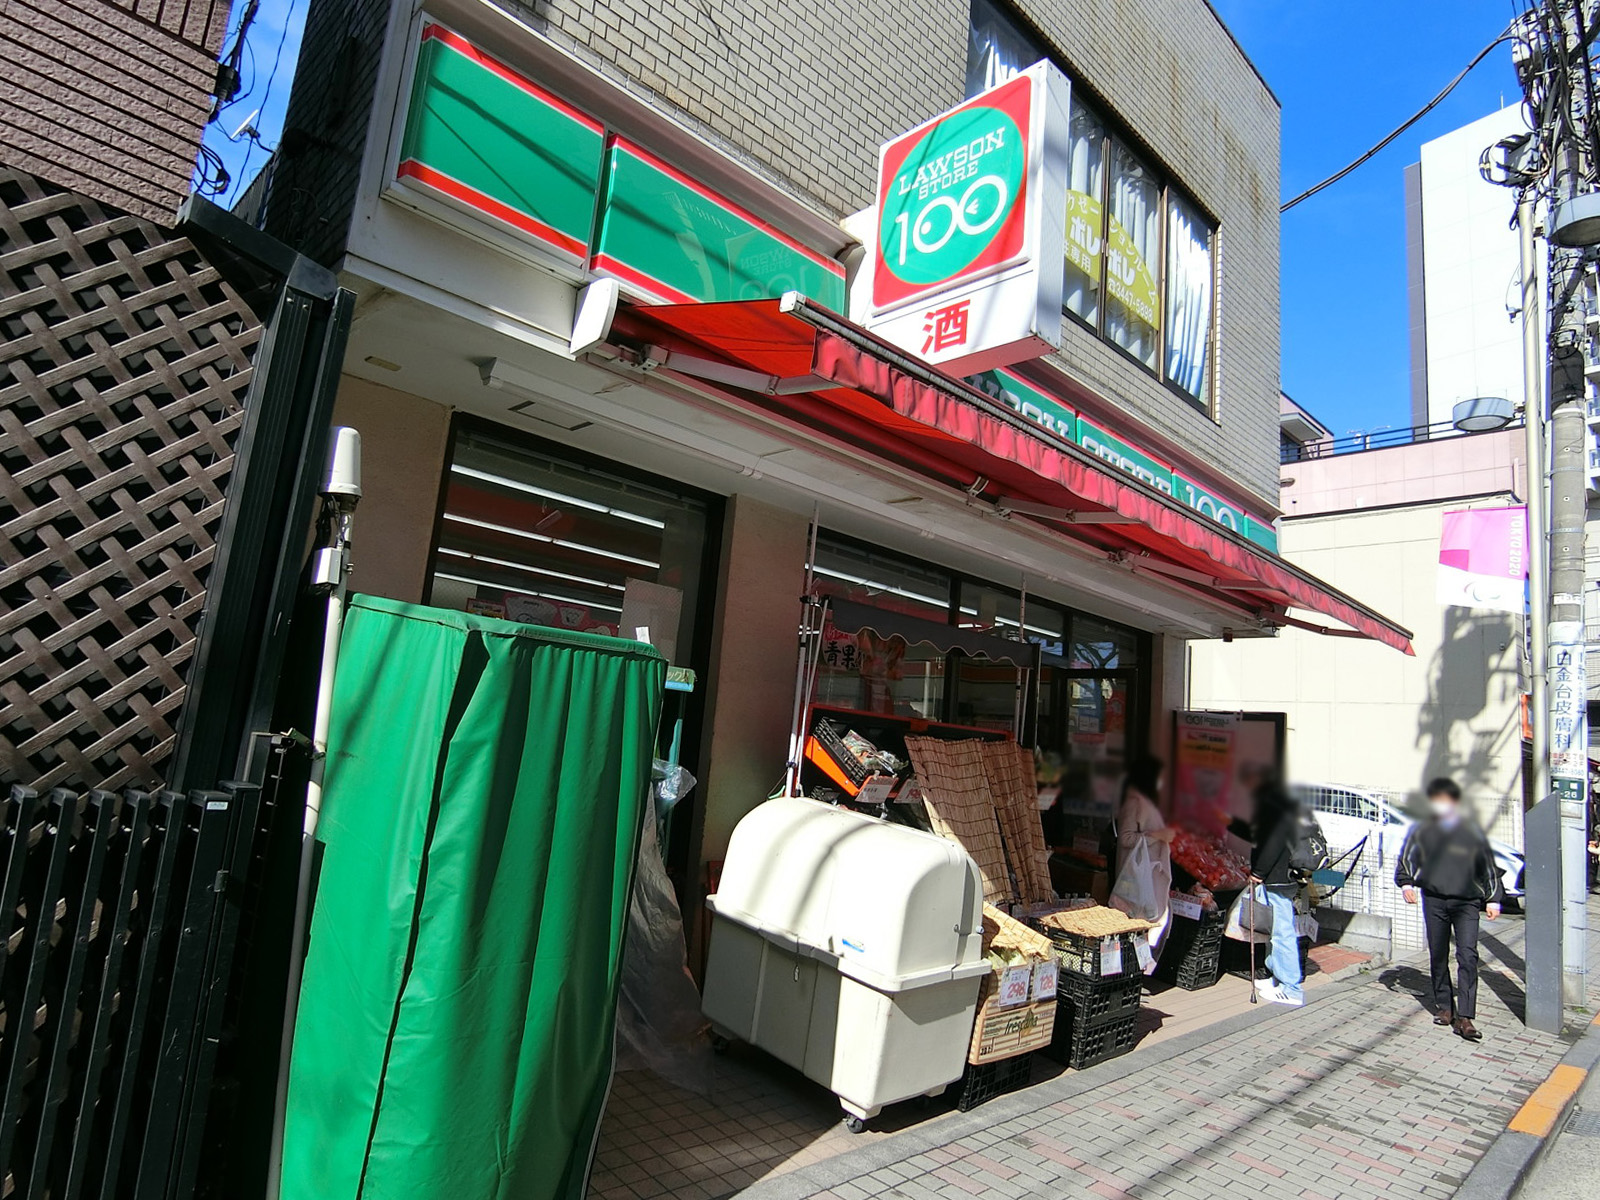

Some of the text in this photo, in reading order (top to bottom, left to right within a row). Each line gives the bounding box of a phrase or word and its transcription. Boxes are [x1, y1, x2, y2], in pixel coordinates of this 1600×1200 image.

[898, 127, 1005, 196] LAWSON
[919, 160, 978, 200] STORE
[895, 175, 1007, 266] 100
[921, 299, 971, 356] 酒
[1508, 513, 1524, 576] TOKYO 2020
[824, 640, 856, 670] 青果
[1555, 649, 1573, 749] 白金台皮膚科
